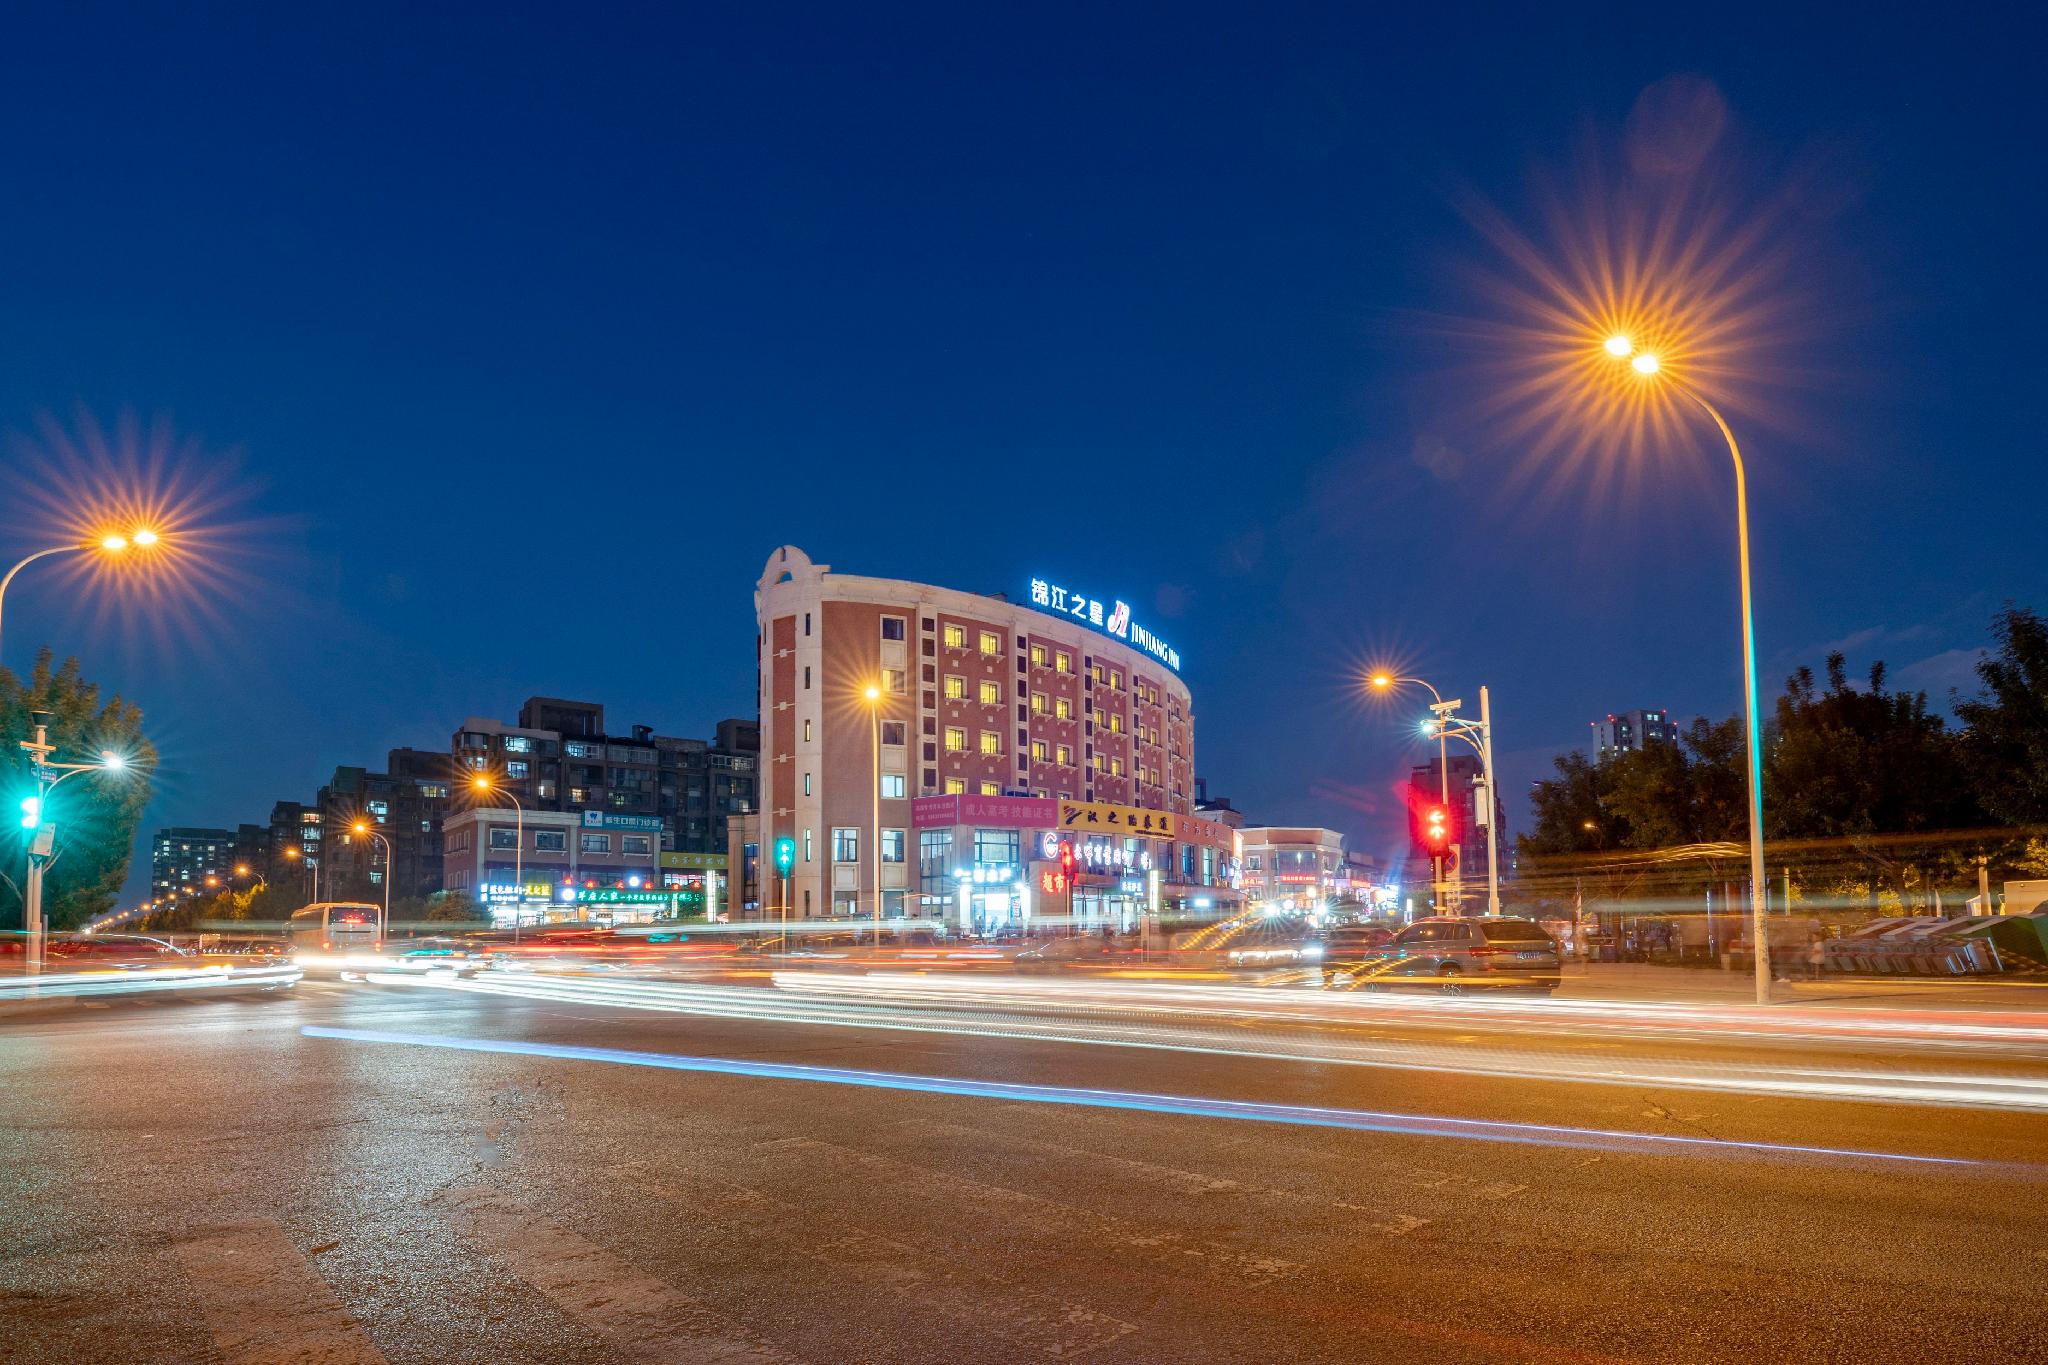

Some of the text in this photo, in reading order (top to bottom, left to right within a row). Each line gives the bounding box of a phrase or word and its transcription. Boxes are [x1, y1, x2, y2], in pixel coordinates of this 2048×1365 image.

[1031, 578, 1103, 626] 锦江之星
[1131, 621, 1180, 671] JINJIANG INN
[1042, 871, 1065, 893] 超市
